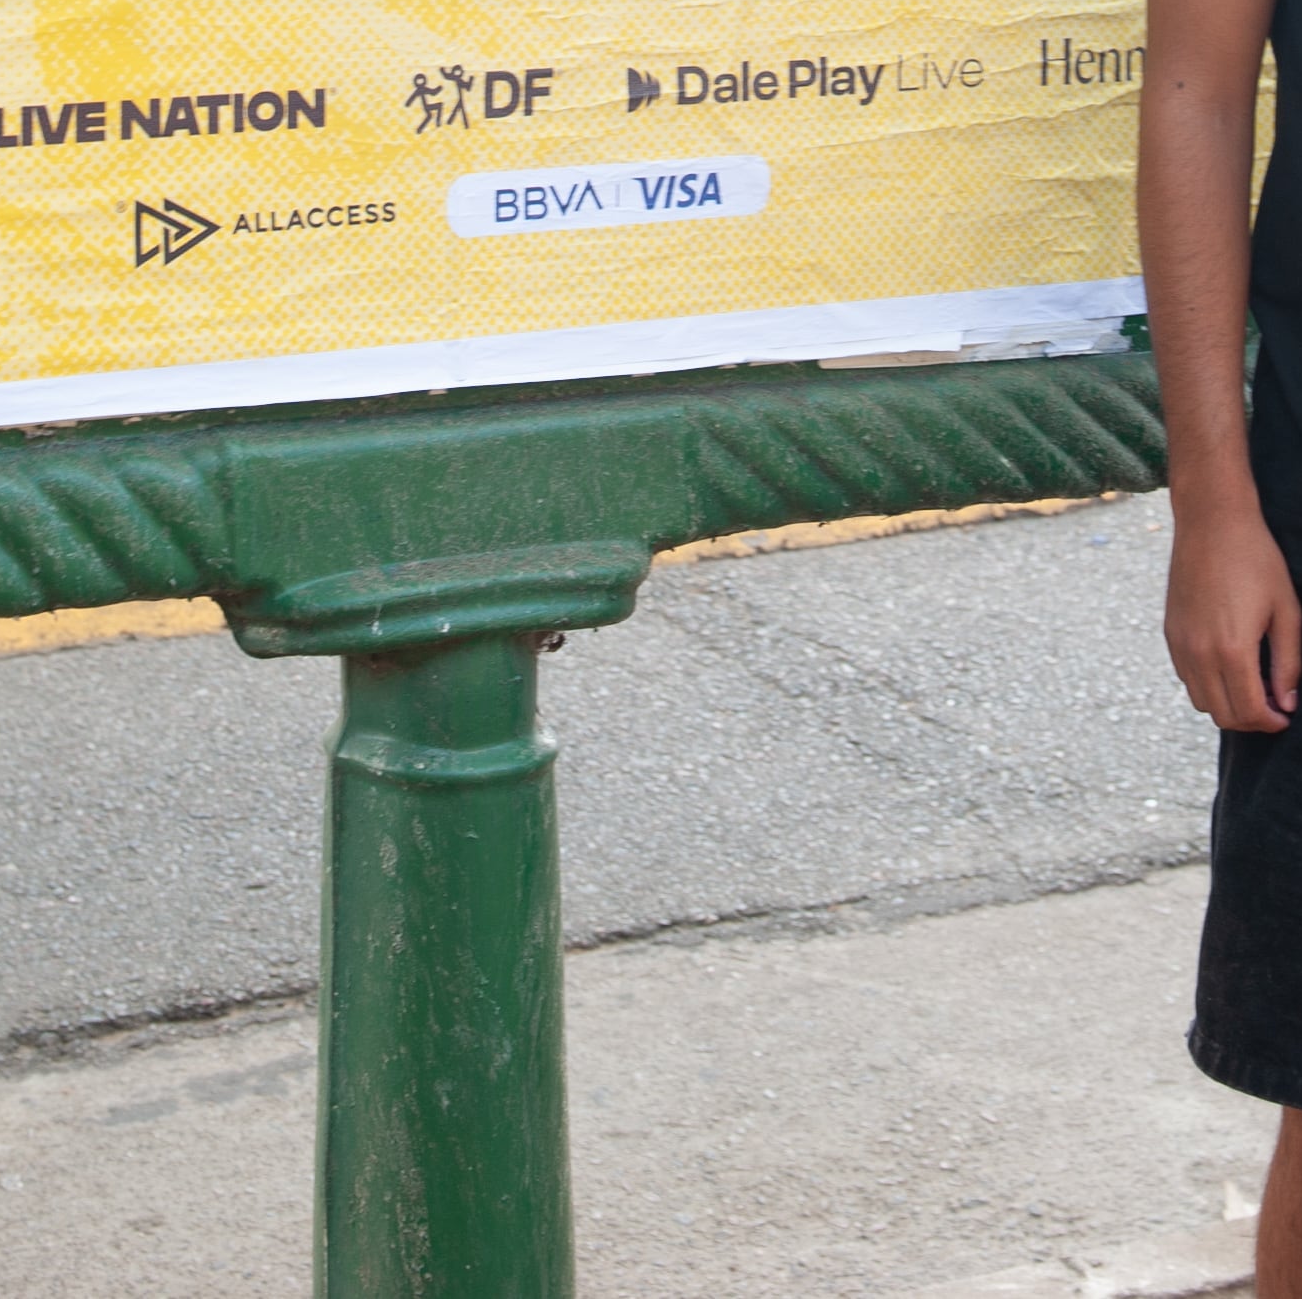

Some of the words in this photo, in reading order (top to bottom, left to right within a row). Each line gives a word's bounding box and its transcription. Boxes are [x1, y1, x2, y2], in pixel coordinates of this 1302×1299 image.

[676, 61, 779, 105] Dale
[788, 57, 885, 106] Play
[897, 52, 985, 92] Live
[1040, 37, 1146, 86] Henn
[120, 88, 326, 140] NATION
[484, 68, 554, 119] DF
[233, 202, 397, 235] ALLACCESS
[495, 181, 603, 223] BBVA
[634, 172, 723, 211] VISA
